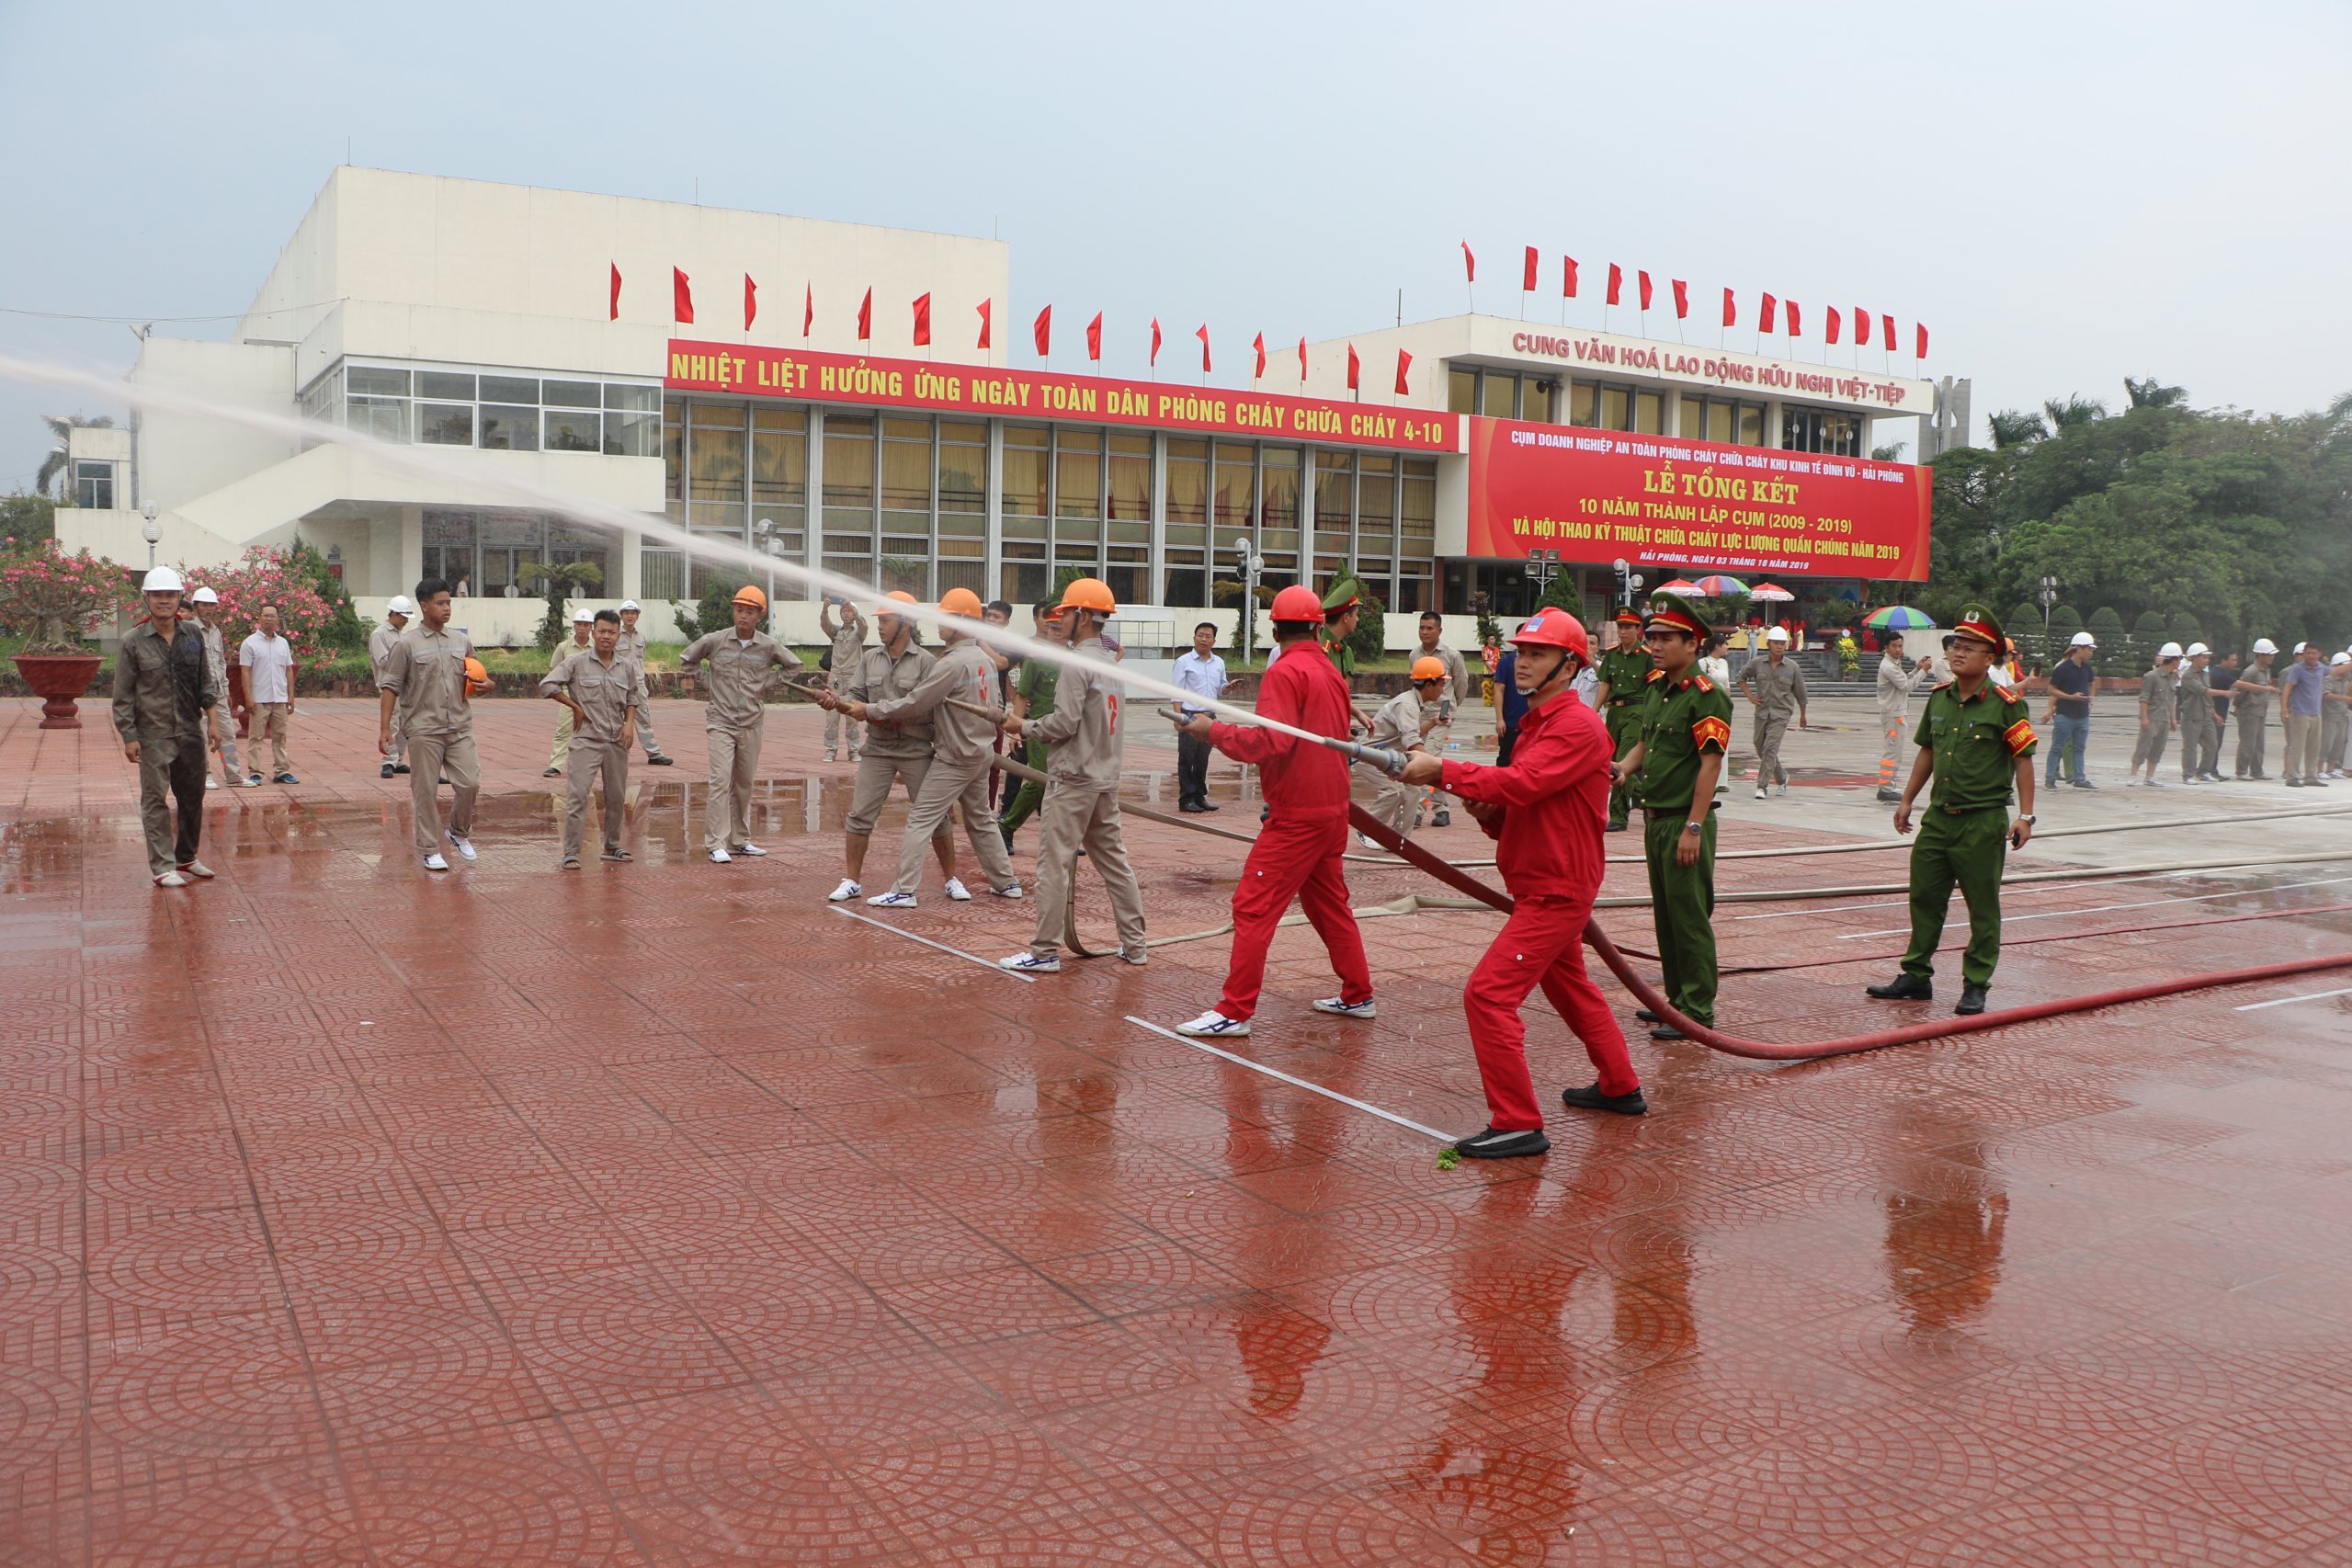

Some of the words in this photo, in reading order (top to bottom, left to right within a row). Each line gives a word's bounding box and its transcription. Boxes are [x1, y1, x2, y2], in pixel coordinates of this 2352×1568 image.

[1513, 333, 1569, 358] CUNG
[1574, 337, 1616, 364] VĂN
[1620, 347, 1660, 369] HOÁ
[1665, 354, 1700, 375] LAO
[1704, 357, 1754, 384] ĐỘNG
[1758, 363, 1792, 388] HỮU
[1796, 372, 1834, 399] NGHỊ
[1836, 376, 1906, 406] VIỆT-TIỆP
[672, 351, 746, 389] NHIỆT
[758, 358, 809, 393] LIỆT
[821, 359, 903, 397] HƯỞNG
[915, 367, 960, 403] ỨNG
[971, 376, 1030, 407] NGÀY
[1041, 383, 1096, 413] TOÀN
[1107, 388, 1150, 417] DÂN
[1159, 397, 1226, 425] PHÒNG
[1235, 401, 1286, 429] CHÁY
[1294, 405, 1344, 435] CHỮA
[1351, 413, 1397, 439] CHÁY
[1404, 420, 1443, 444] 4-10
[1511, 430, 1536, 448] CỤM
[1538, 433, 1574, 449] DOANH
[1576, 437, 1613, 455] NGHIỆP
[1615, 441, 1630, 455] AN
[1631, 442, 1657, 458] TOÀN
[1659, 445, 1691, 460] PHÒNG
[1693, 448, 1717, 464] CHÁY
[1719, 450, 1744, 467] CHỮA
[1745, 453, 1768, 470] CHÁY
[1770, 458, 1788, 472] KHU
[1790, 460, 1810, 473] KINH
[1811, 460, 1823, 474] TẾ
[1823, 461, 1843, 476] ĐÌNH
[1845, 464, 1856, 478] VŨ
[1862, 464, 1876, 480] HẢI
[1878, 467, 1904, 483] PHÒNG
[1643, 460, 1676, 494] LỄ
[1682, 466, 1747, 501] TỔNG
[1752, 475, 1800, 505] KẾT
[1579, 497, 1597, 514] 10
[1602, 495, 1640, 517] NĂM
[1643, 501, 1697, 521] THÀNH
[1700, 505, 1729, 527] LẬP
[1732, 510, 1765, 530] CỤM
[1768, 513, 1806, 530] (2009
[1817, 517, 1853, 535] 2019)
[1513, 516, 1530, 536] VÀ
[1533, 517, 1556, 540] HỘI
[1559, 521, 1592, 540] THAO
[1595, 522, 1611, 540] KỸ
[1614, 523, 1652, 546] THUẬT
[1654, 526, 1687, 546] CHỮA
[1688, 530, 1718, 548] CHÁY
[1721, 533, 1742, 552] LỰC
[1745, 535, 1780, 554] LƯỢNG
[1783, 534, 1812, 554] QUẦN
[1814, 538, 1849, 557] CHÚNG
[1851, 540, 1875, 558] NĂM
[1877, 545, 1901, 560] 2019
[1640, 550, 1656, 561] HẢI
[1691, 554, 1715, 564] NGÀY
[1716, 557, 1727, 565] 03
[1729, 555, 1755, 567] THÁNG
[1757, 559, 1767, 567] 10
[1768, 558, 1788, 568] NĂM
[1789, 562, 1810, 570] 2019
[1108, 694, 1118, 735] 2
